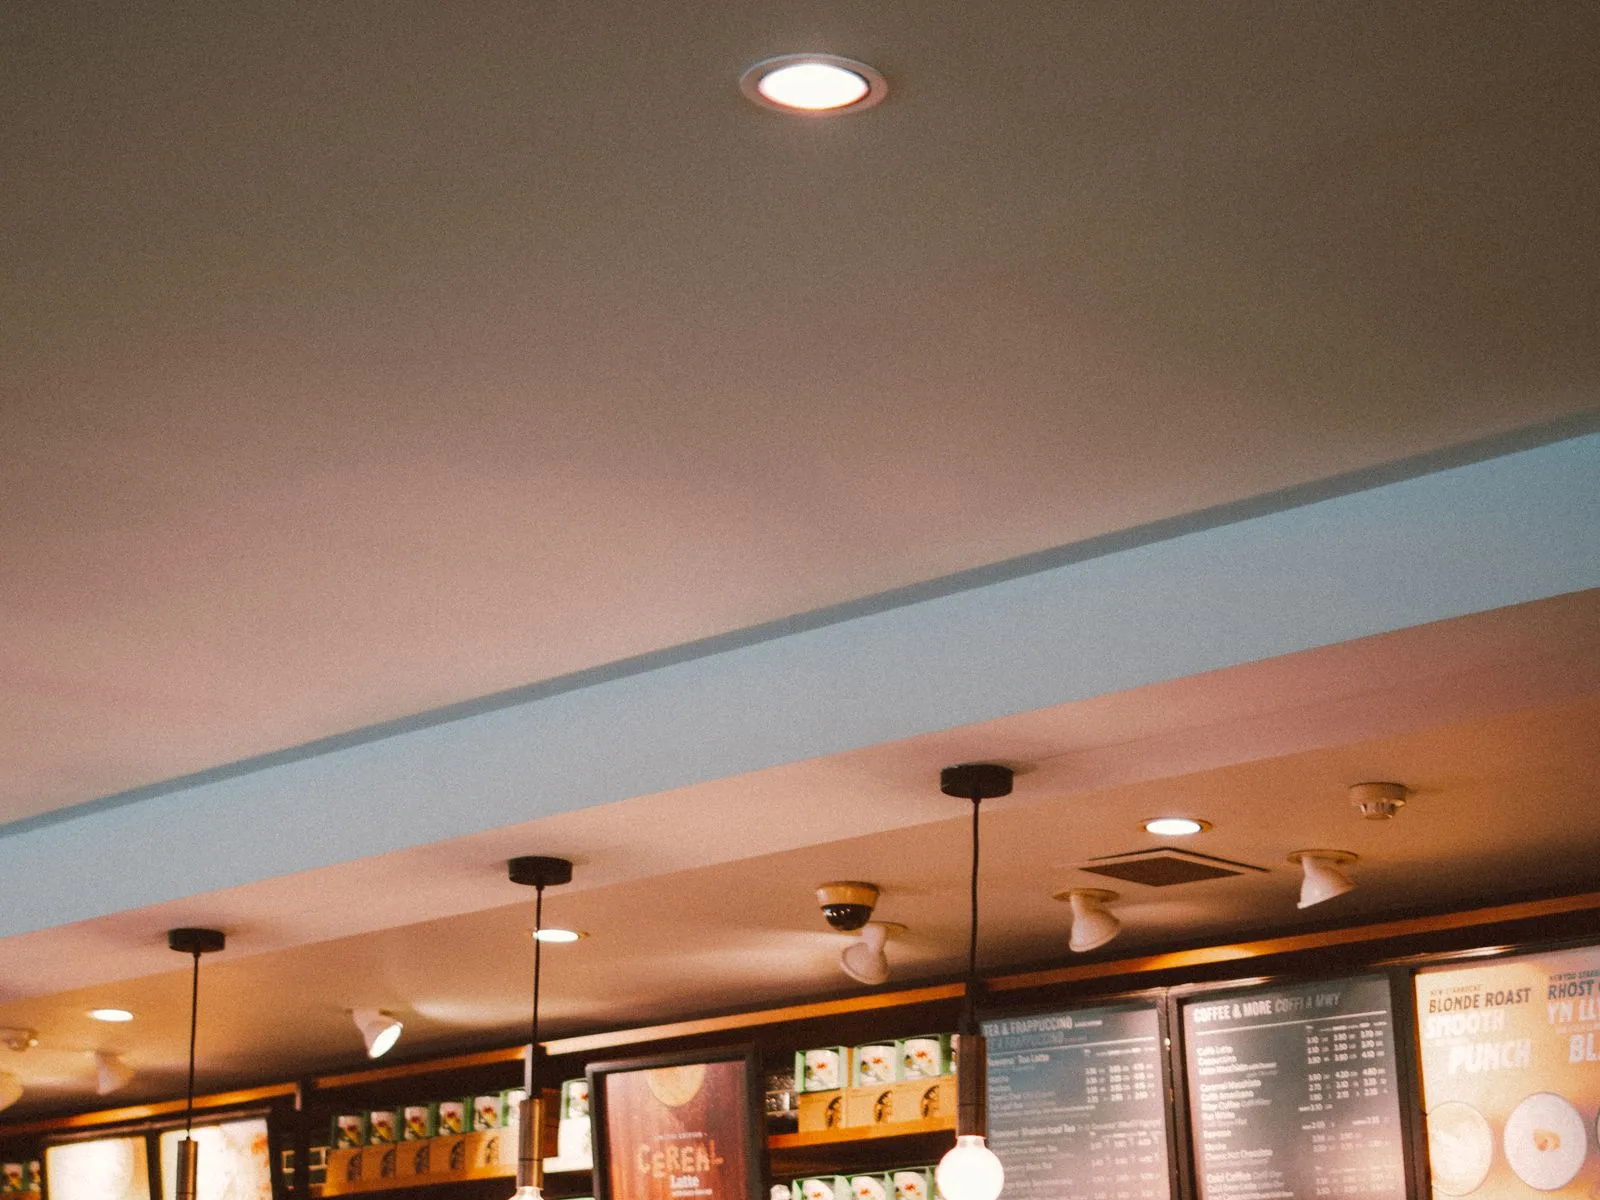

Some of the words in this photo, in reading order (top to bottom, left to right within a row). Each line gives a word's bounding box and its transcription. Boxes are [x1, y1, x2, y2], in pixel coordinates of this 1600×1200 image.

[1194, 1005, 1231, 1023] COFFEE
[1232, 1003, 1242, 1019] &
[1243, 1000, 1272, 1017] MORE
[1429, 994, 1480, 1013] BLONDE
[1485, 988, 1531, 1008] ROAST
[638, 1140, 724, 1178] CEREAL
